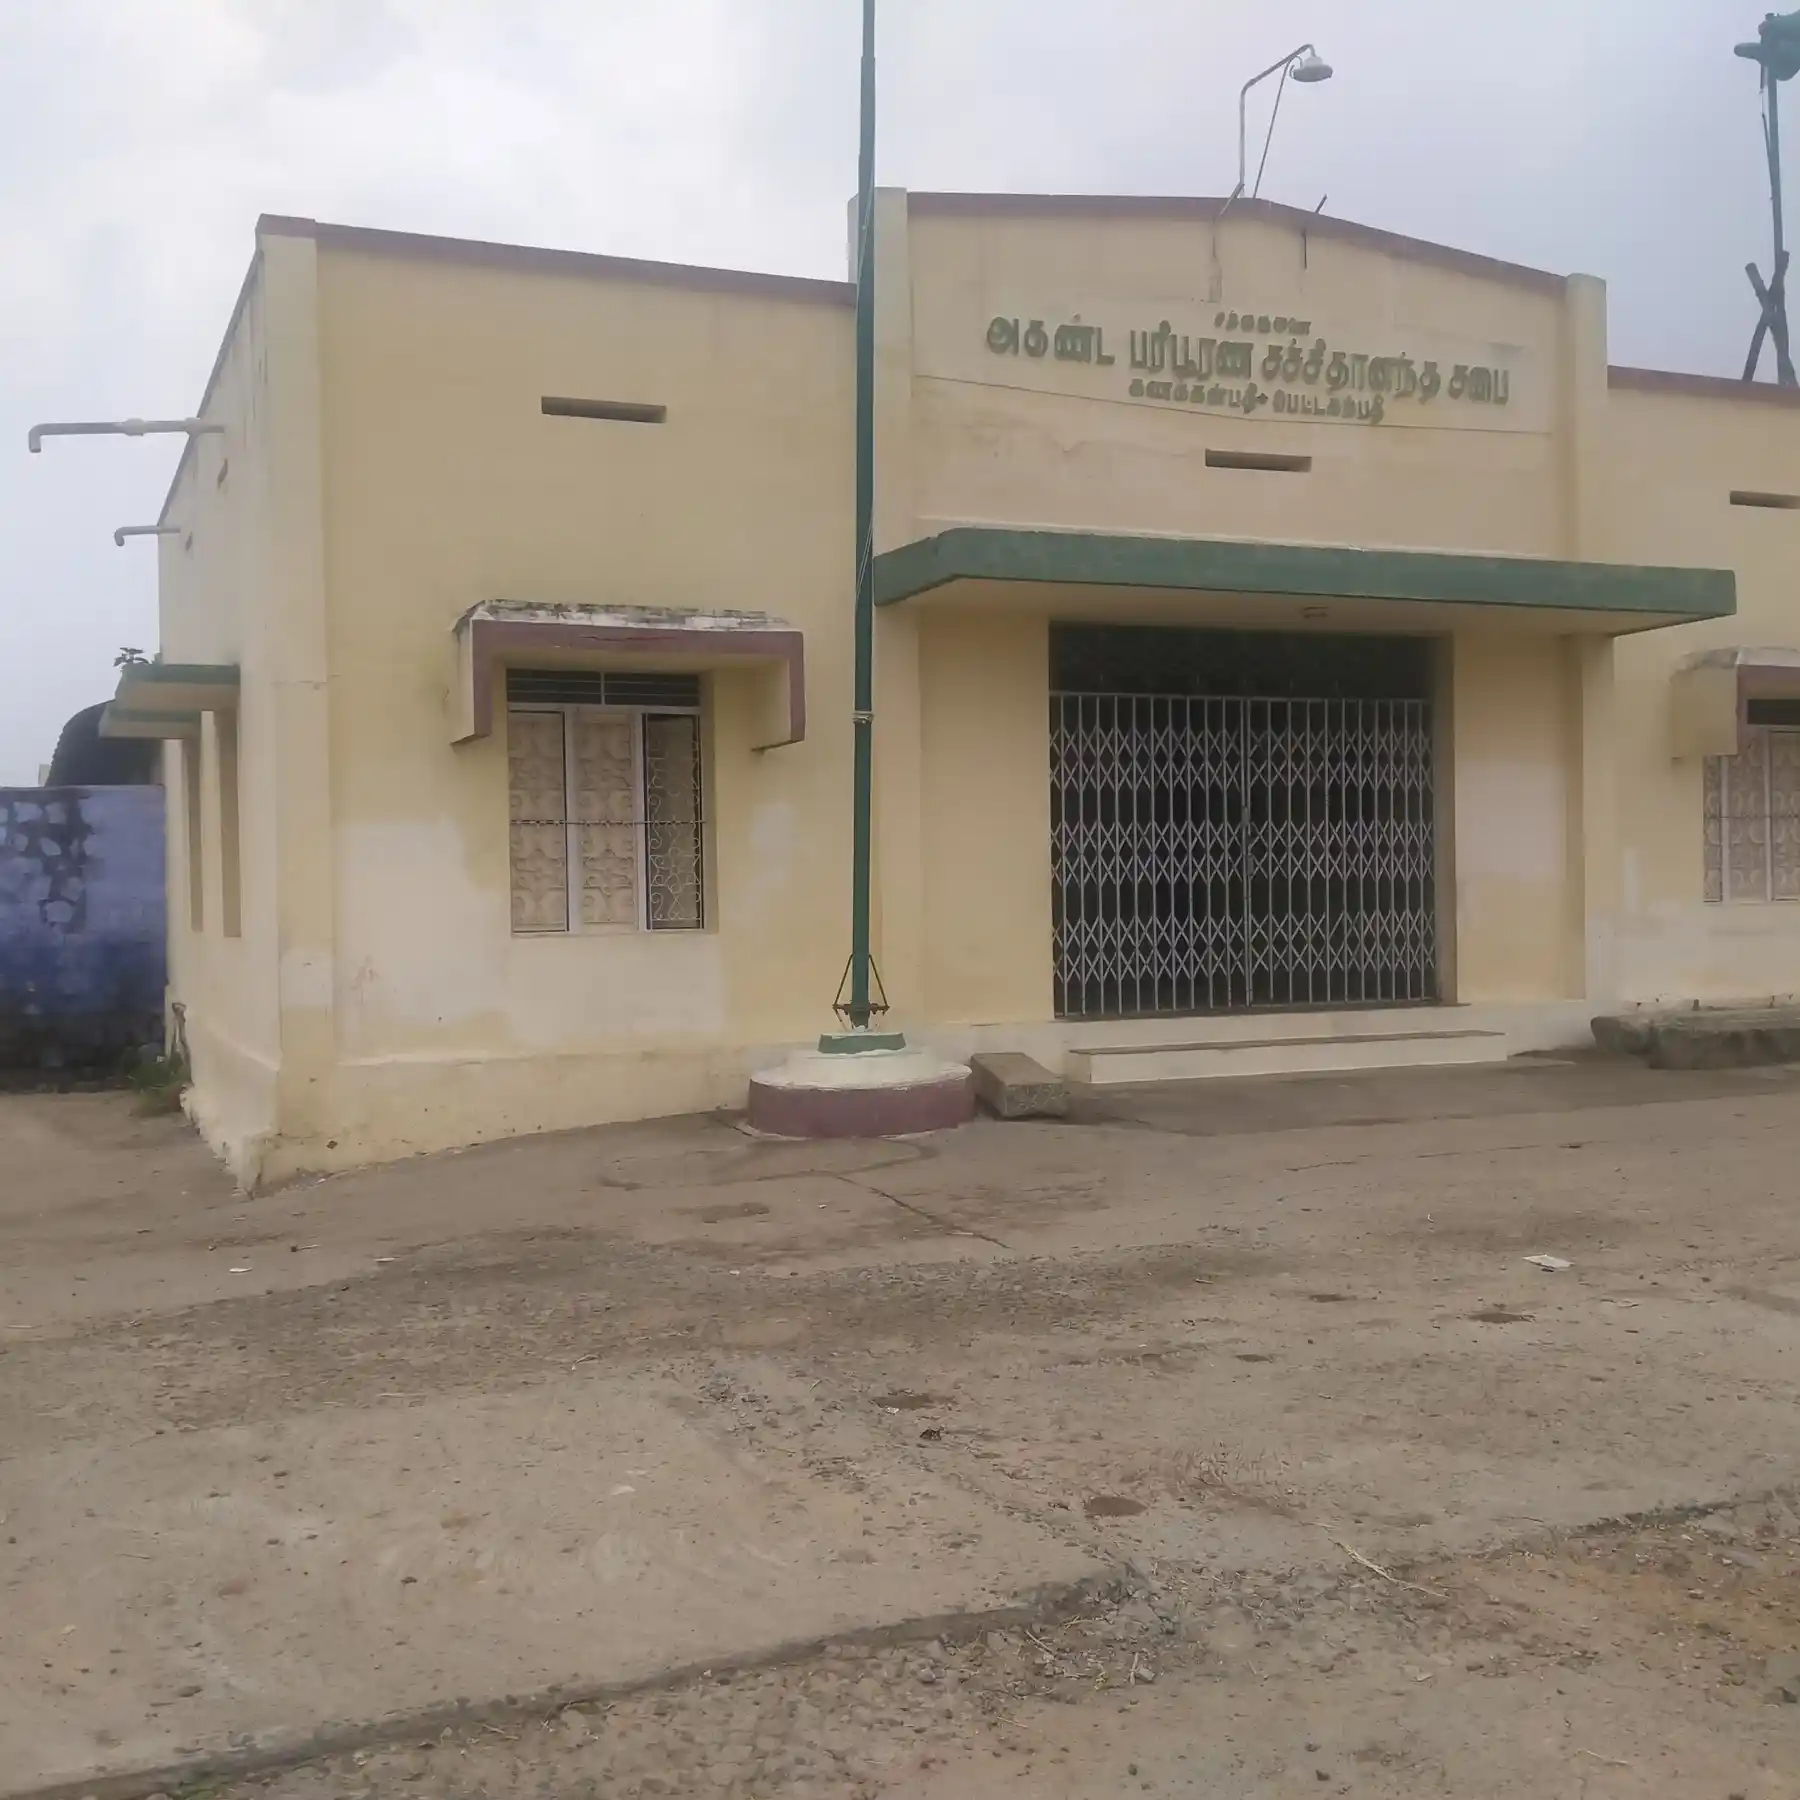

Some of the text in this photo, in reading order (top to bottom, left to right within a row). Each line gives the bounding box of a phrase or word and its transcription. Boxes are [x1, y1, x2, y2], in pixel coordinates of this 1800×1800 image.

[986, 313, 1116, 366] அகண்ட
[1129, 319, 1255, 381] பரிபூரண
[1447, 363, 1510, 405] சபை
